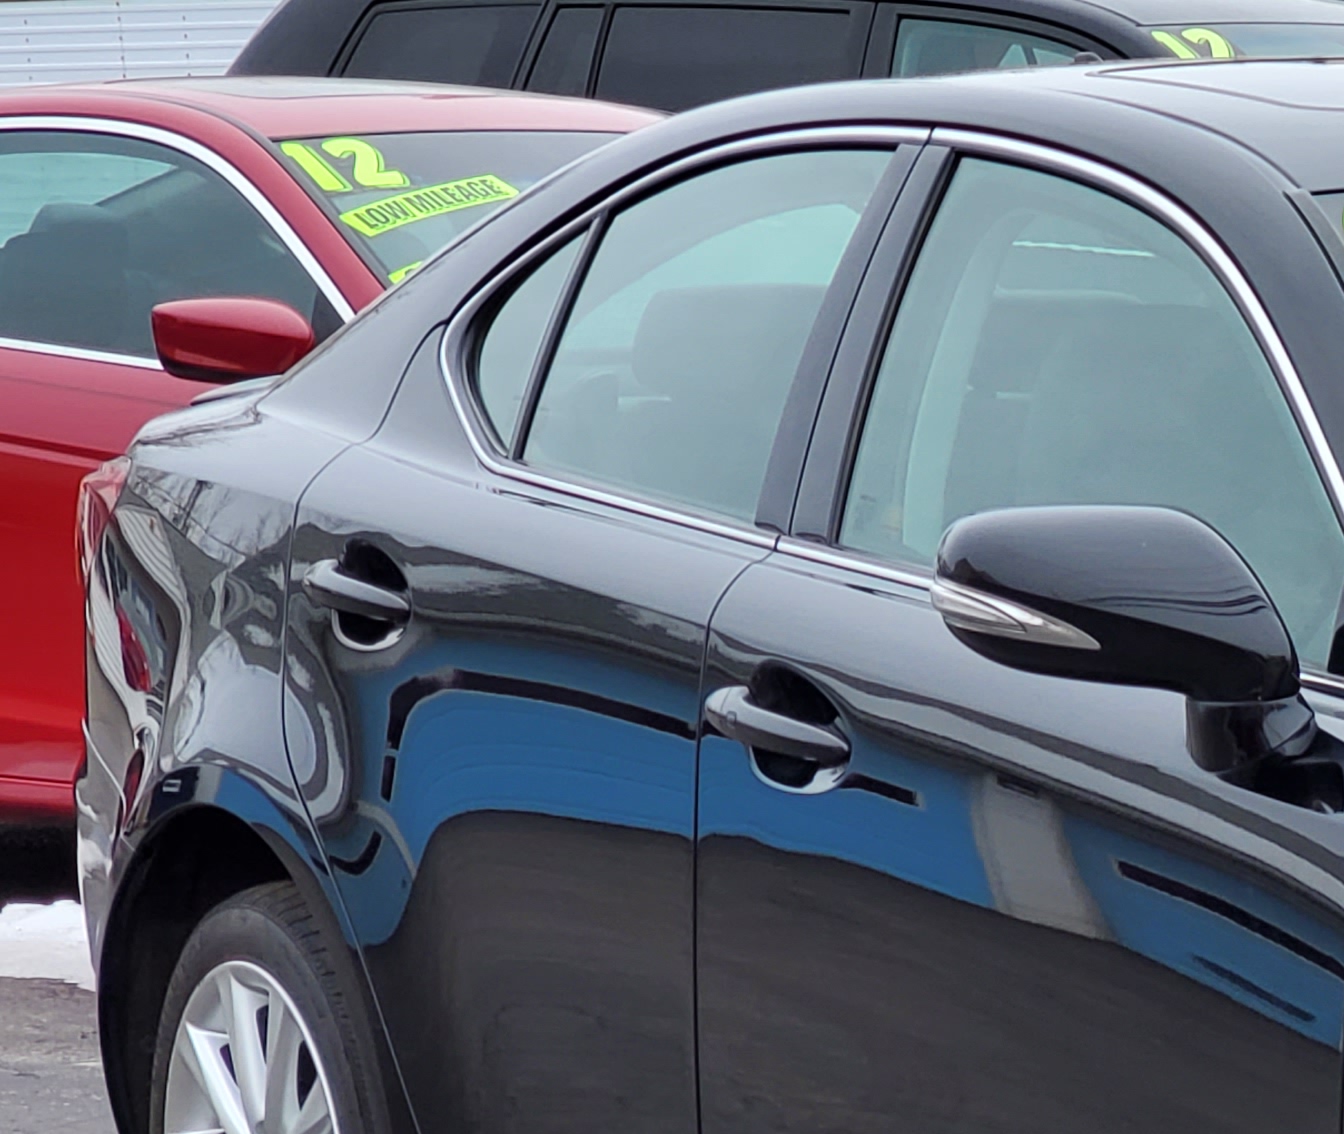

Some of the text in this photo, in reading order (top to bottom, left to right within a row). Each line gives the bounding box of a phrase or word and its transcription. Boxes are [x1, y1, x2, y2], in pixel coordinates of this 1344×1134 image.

[281, 137, 410, 192] 12
[353, 179, 504, 229] LOW MILEAGE
